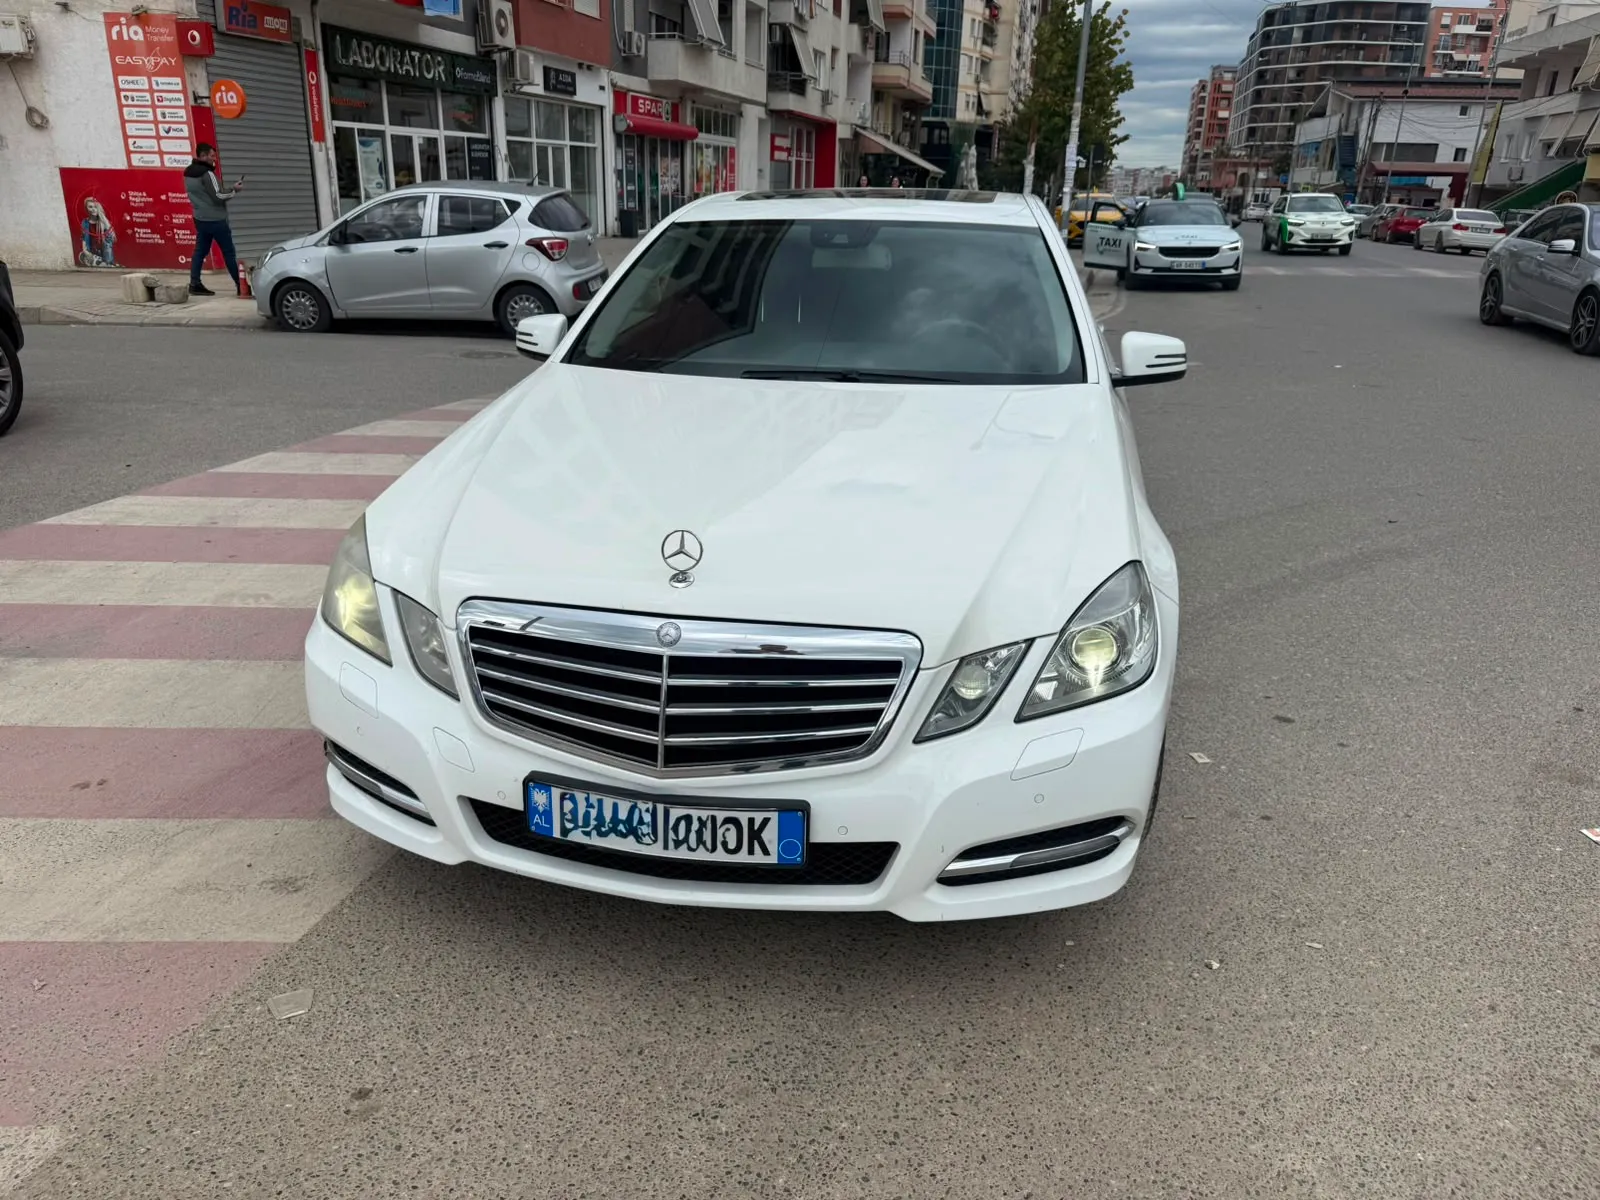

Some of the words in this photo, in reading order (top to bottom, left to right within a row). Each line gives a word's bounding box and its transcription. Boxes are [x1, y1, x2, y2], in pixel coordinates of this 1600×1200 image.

[228, 4, 258, 29] Ria
[111, 17, 144, 41] ria
[145, 25, 170, 34] Money
[147, 34, 174, 42] Transfer
[335, 34, 446, 82] LABORATOR
[215, 85, 238, 104] ria
[637, 99, 663, 116] SPAR
[1099, 237, 1122, 248] TAXI
[533, 814, 550, 828] AL
